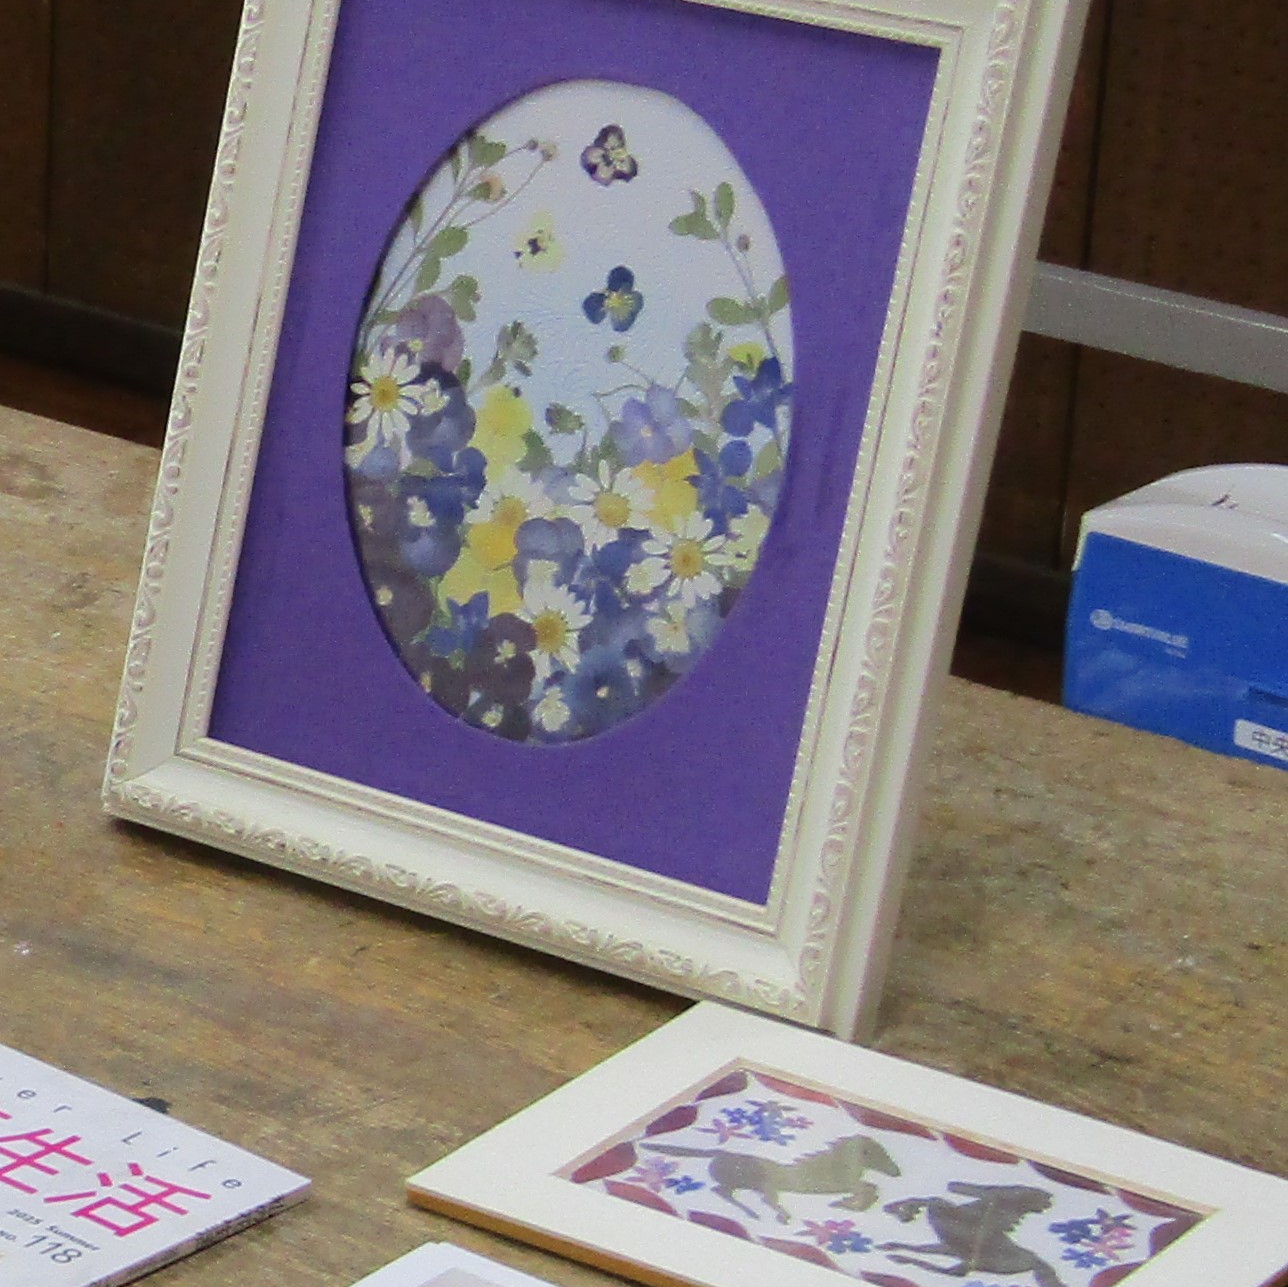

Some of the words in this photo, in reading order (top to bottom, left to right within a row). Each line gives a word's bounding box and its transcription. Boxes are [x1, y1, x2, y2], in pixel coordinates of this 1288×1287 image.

[120, 1131, 243, 1190] Life
[6, 1208, 44, 1226] 2025
[45, 1225, 100, 1251] Summer
[24, 1235, 83, 1264] 118
